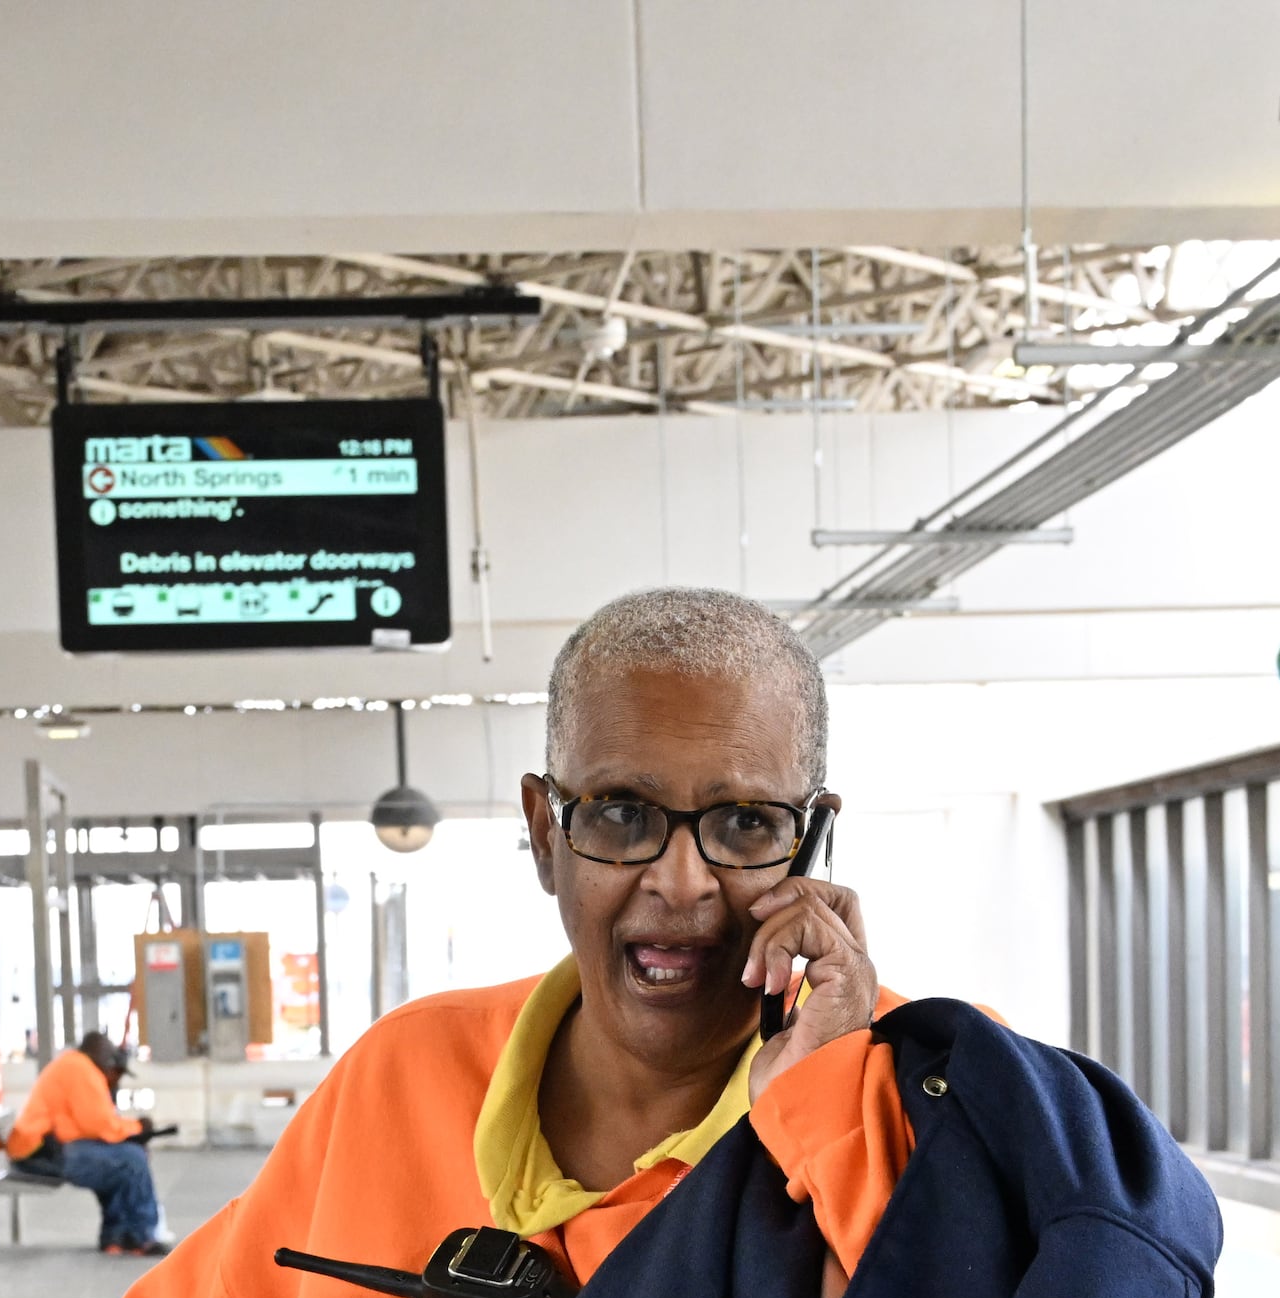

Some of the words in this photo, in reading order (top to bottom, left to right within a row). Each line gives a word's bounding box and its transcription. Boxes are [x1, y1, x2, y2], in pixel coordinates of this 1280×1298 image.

[86, 434, 192, 462] marta
[384, 438, 413, 457] PM
[122, 469, 186, 488] North
[194, 467, 282, 491] Springs
[349, 467, 357, 484] 1
[367, 467, 410, 484] min
[121, 552, 192, 574] Debris
[195, 551, 217, 573] in
[219, 550, 308, 572] elevator
[310, 549, 416, 573] doorways
